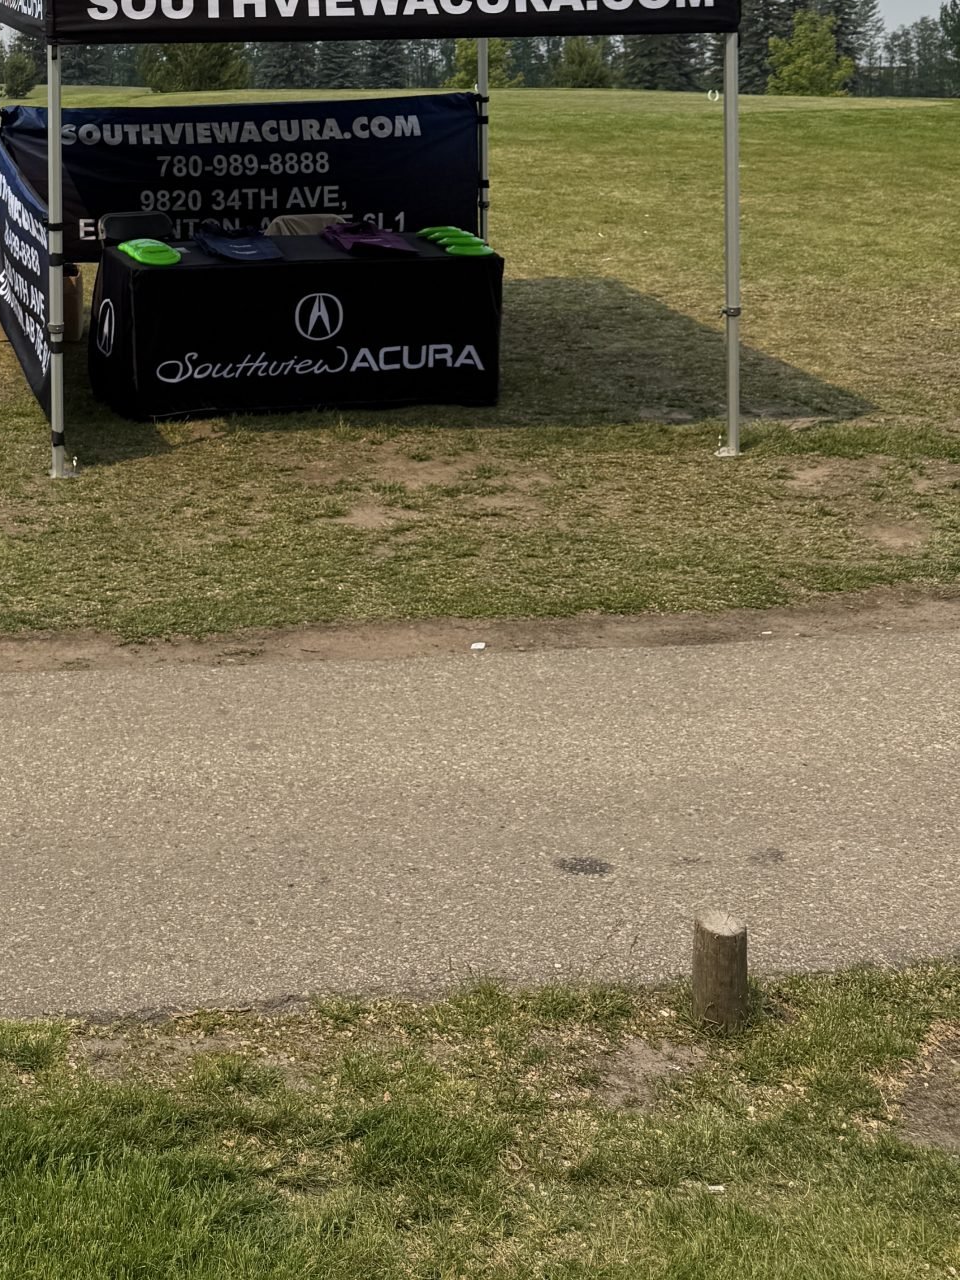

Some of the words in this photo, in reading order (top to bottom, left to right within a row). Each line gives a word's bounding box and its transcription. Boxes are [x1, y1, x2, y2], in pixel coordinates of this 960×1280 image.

[61, 114, 422, 146] SOUTHVIEWACURA.COM
[156, 151, 330, 178] 780-989-8888
[140, 189, 202, 212] 9820
[211, 187, 278, 211] 34TH
[286, 185, 347, 211] AVE,
[156, 346, 348, 383] Southview
[350, 343, 485, 372] ACURA
